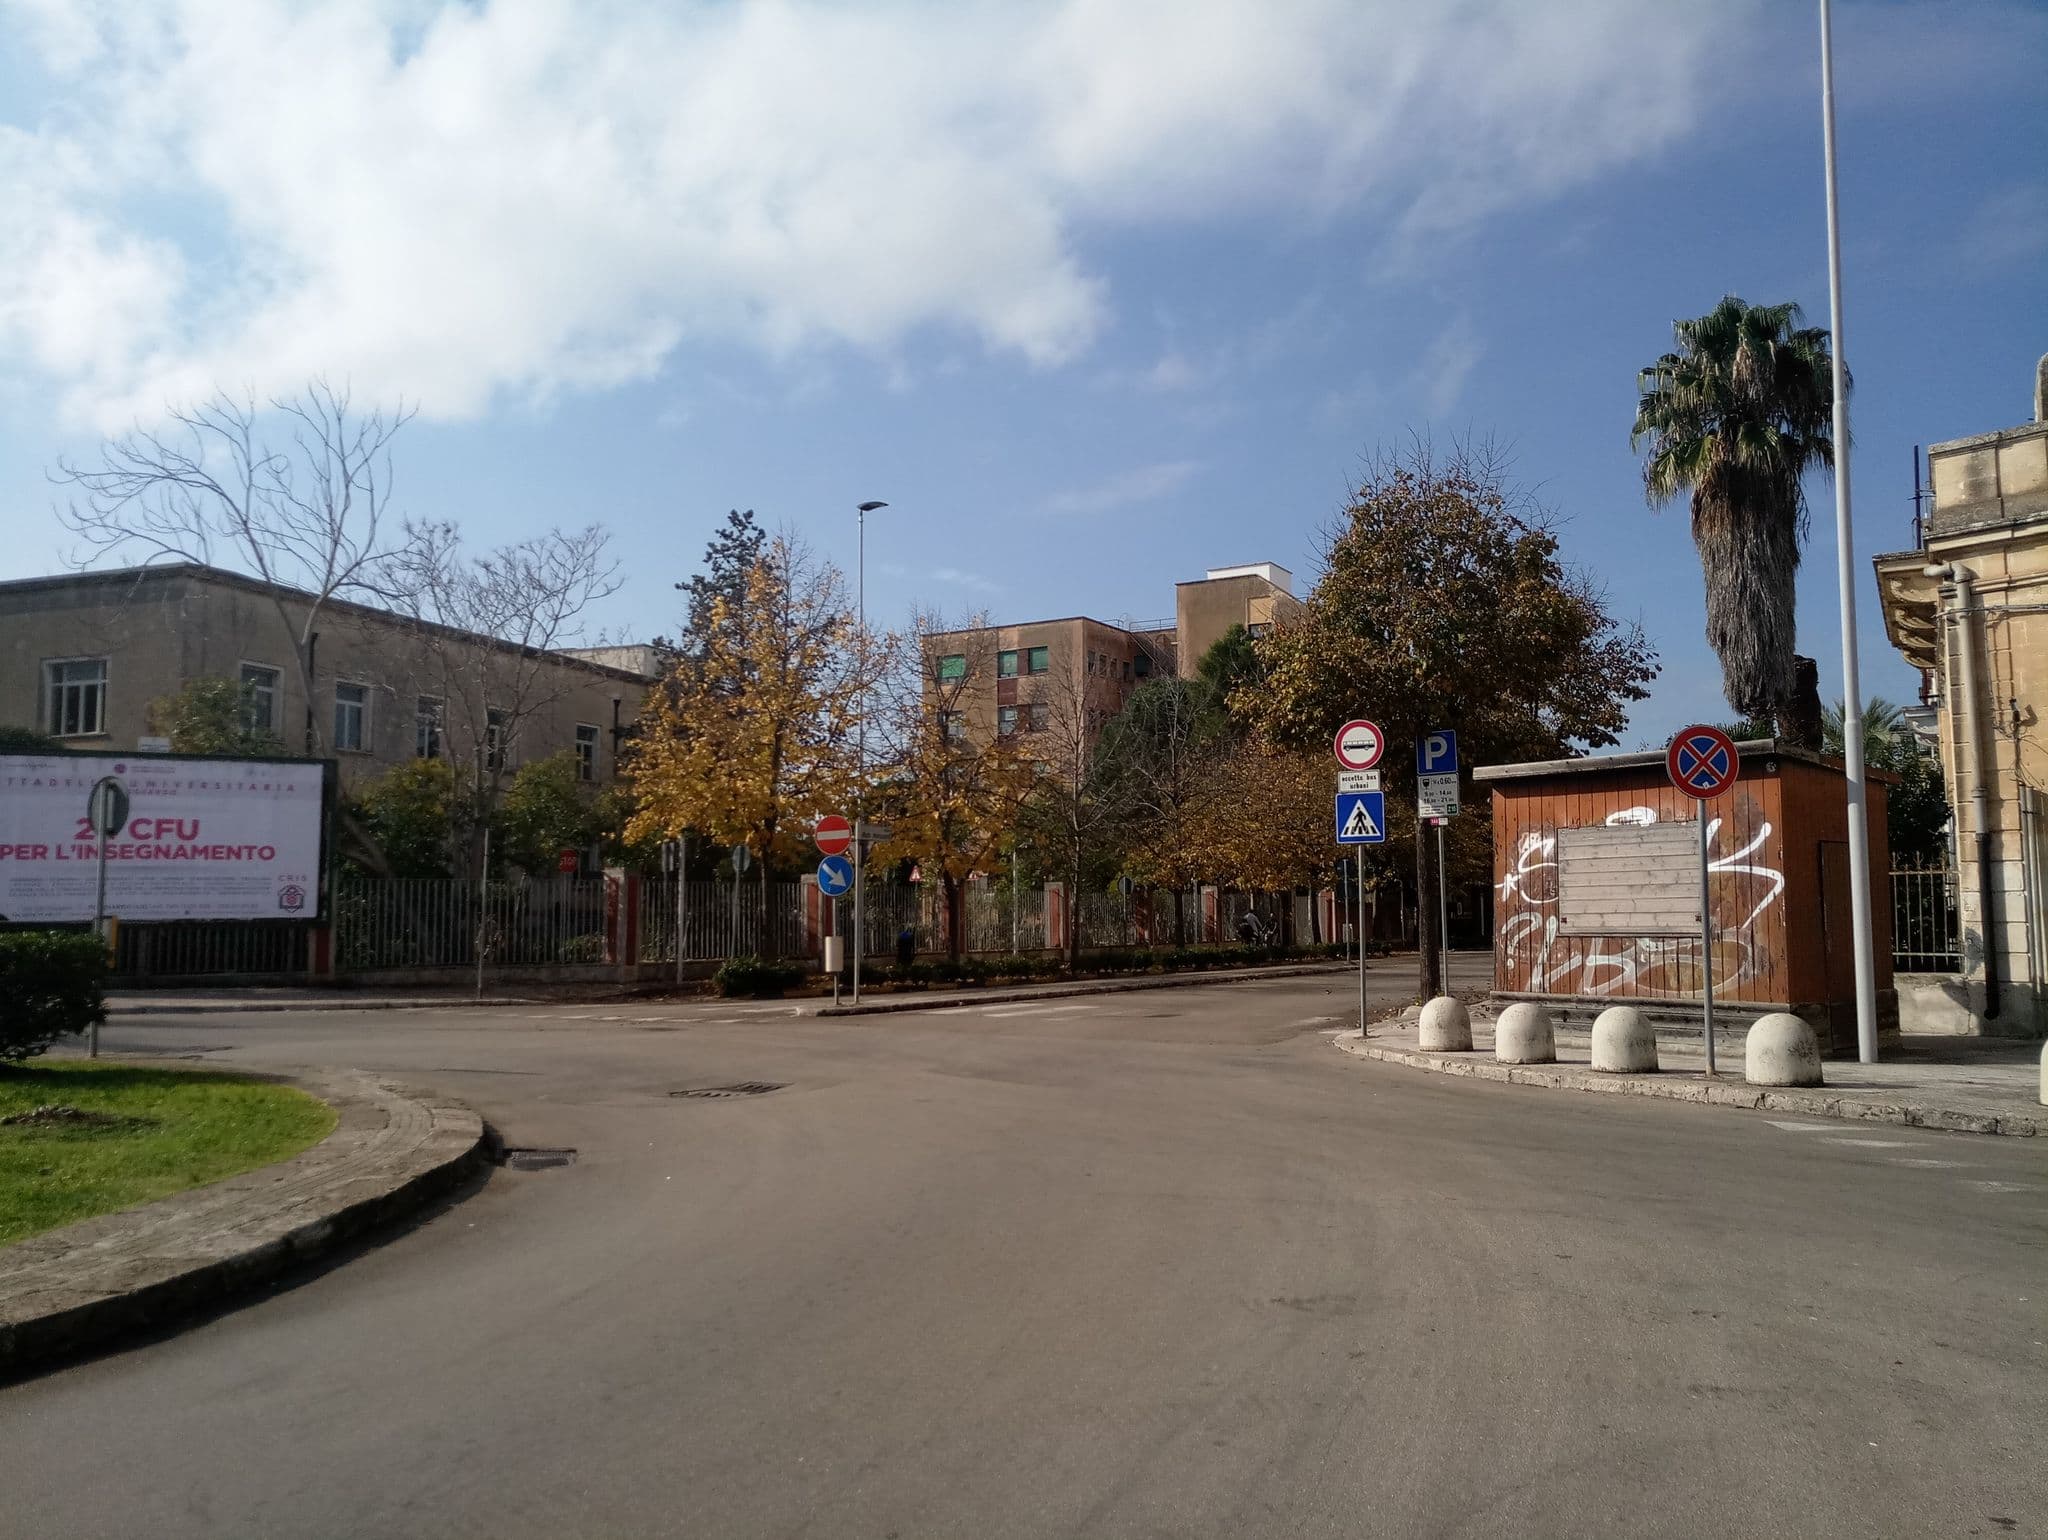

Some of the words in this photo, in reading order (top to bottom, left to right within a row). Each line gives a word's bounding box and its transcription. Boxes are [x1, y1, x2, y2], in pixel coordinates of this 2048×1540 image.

[1424, 736, 1448, 770] P
[1350, 782, 1369, 790] urbani
[1366, 773, 1377, 781] bus
[128, 818, 200, 842] CFU
[0, 843, 48, 861] PER
[55, 843, 276, 861] L'INSEGNAMENTO
